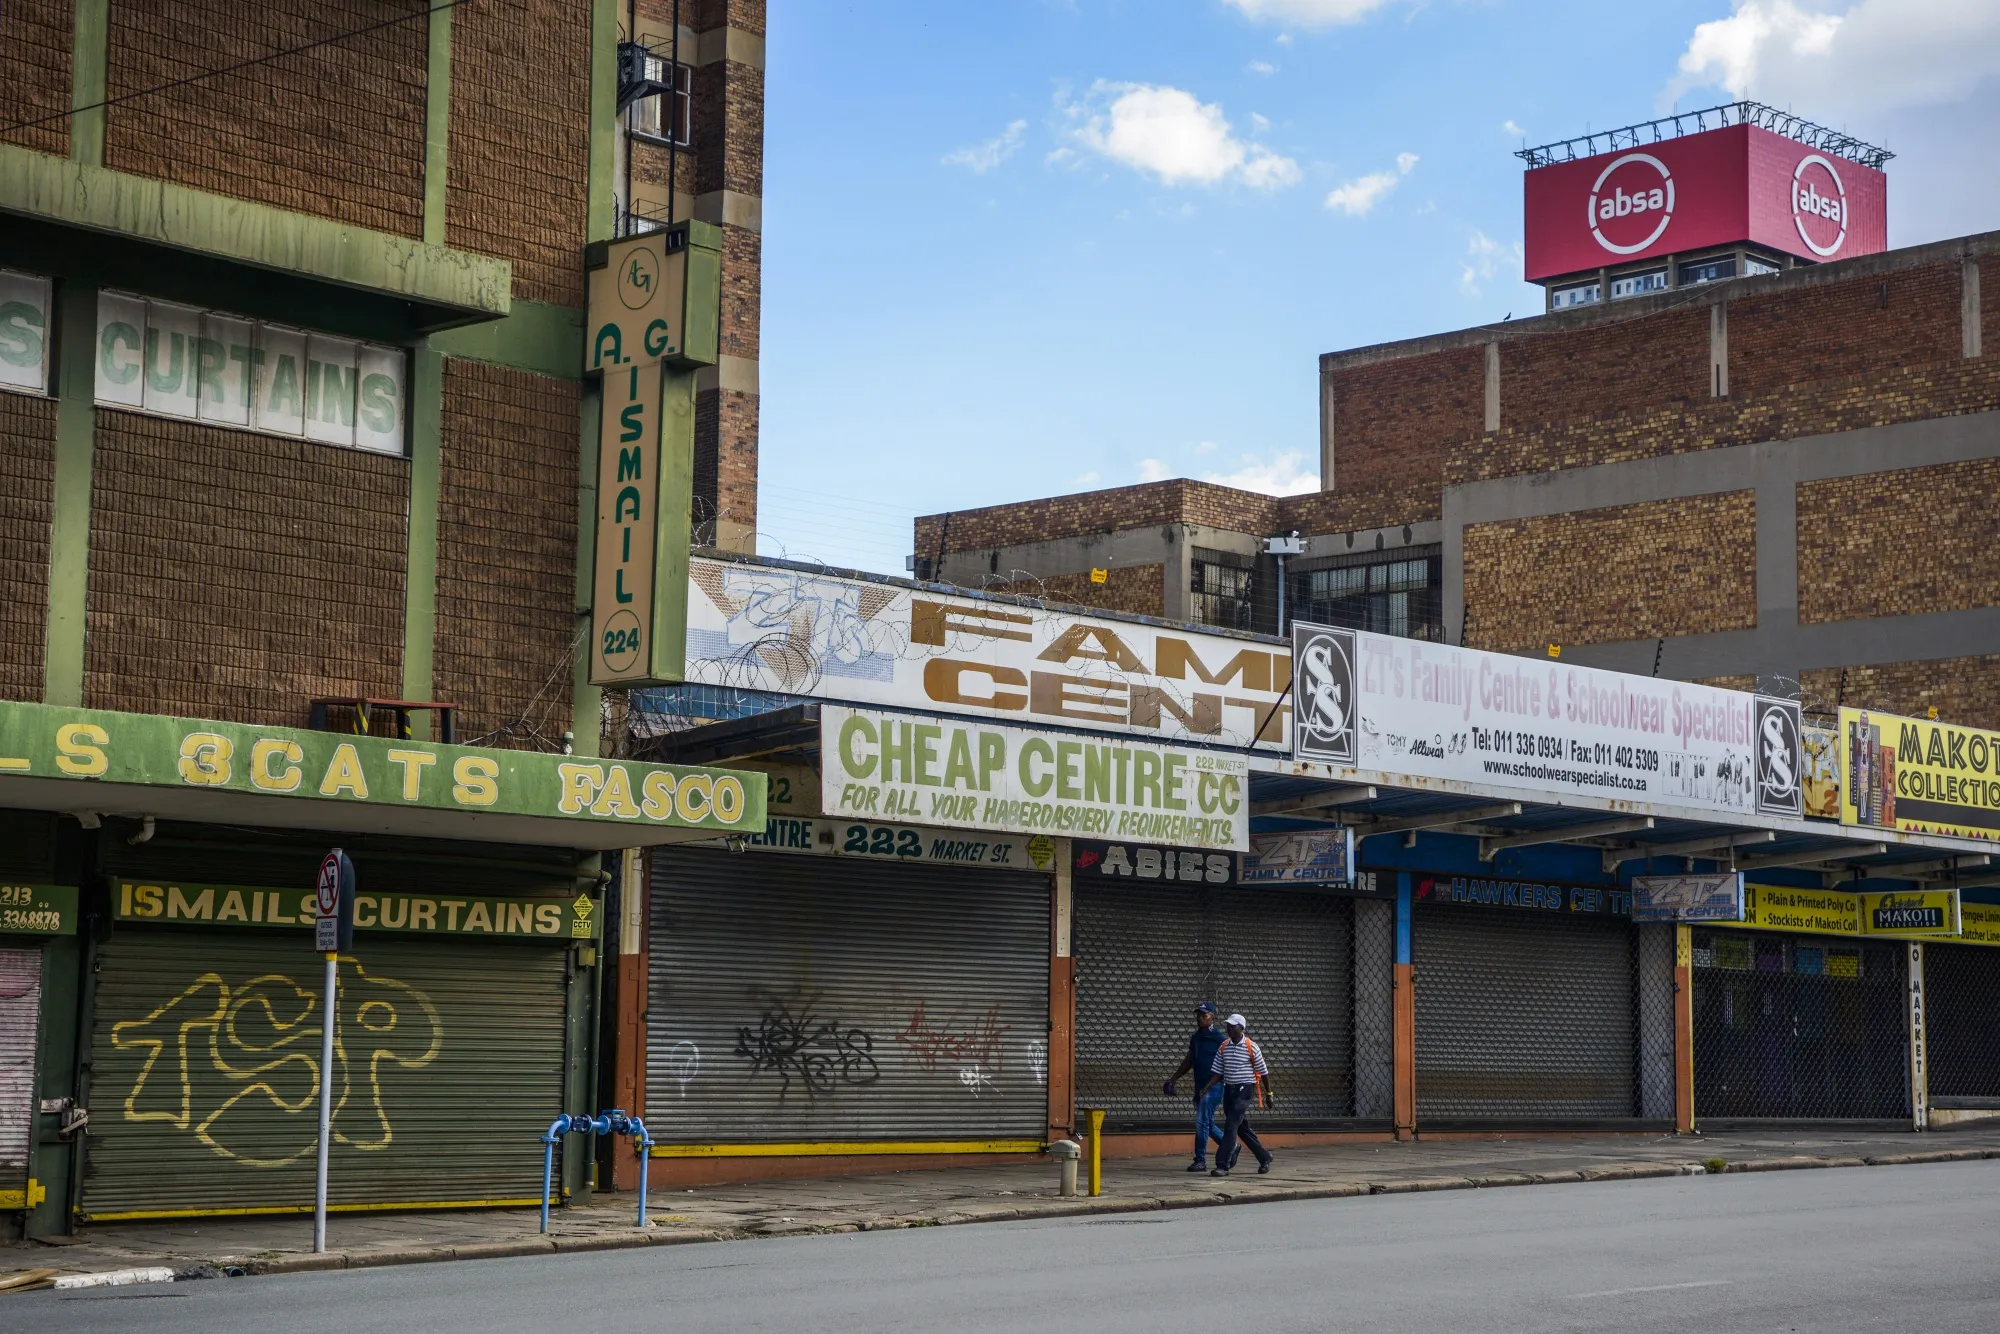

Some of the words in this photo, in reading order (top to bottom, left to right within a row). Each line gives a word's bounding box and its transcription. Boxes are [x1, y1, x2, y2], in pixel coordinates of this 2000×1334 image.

[1600, 186, 1664, 220] absa
[1799, 183, 1841, 222] absa
[594, 322, 631, 367] A.
[644, 318, 675, 358] G.
[100, 321, 397, 433] CURTAINS
[615, 365, 644, 604] ISMAIL
[604, 625, 639, 655] 224
[1410, 645, 1474, 721] Family
[1480, 656, 1541, 717] Centre
[1548, 667, 1560, 719] &
[1567, 668, 1667, 734] Schoolwear
[1672, 685, 1751, 750] Specialist
[838, 715, 1005, 792] CHEAP
[1018, 736, 1188, 812] CENTRE
[1195, 755, 1214, 770] 222
[1471, 726, 1491, 750] Tel:
[1494, 729, 1512, 753] 011
[1516, 732, 1535, 756] 336
[1538, 735, 1562, 760] 0934
[1571, 740, 1592, 763] Fax:
[1594, 742, 1612, 766] 011
[1615, 745, 1633, 769] 402
[1636, 748, 1659, 772] 5309
[557, 763, 745, 824] FASCO
[1198, 773, 1240, 815] CC
[1484, 760, 1647, 791] www.schoolwearspecialist.co.za
[840, 783, 881, 813] FOR
[883, 788, 921, 816] ALL
[931, 792, 978, 822] YOUR
[983, 797, 1115, 834] HABERDASHERY
[1117, 810, 1236, 845] REQUIREMENTS.
[844, 825, 922, 858] 222
[929, 838, 986, 862] MARKET
[990, 843, 1010, 863] ST.
[1101, 846, 1231, 884] ABIES
[1242, 869, 1285, 881] FAMILY
[1293, 867, 1345, 879] CENTRE
[120, 883, 317, 925] ISMAILS
[353, 896, 562, 934] CURTAINS
[1451, 877, 1562, 909] HAWKERS
[1768, 892, 1788, 906] Plain
[1789, 894, 1796, 906] &
[1797, 895, 1826, 910] Printed
[1828, 898, 1844, 914] Poly
[1768, 912, 1804, 927] Stockists
[1805, 916, 1814, 928] of
[1815, 917, 1842, 931] Makoti
[1879, 909, 1936, 922] MAKOTI
[1961, 927, 1985, 941] Butcher
